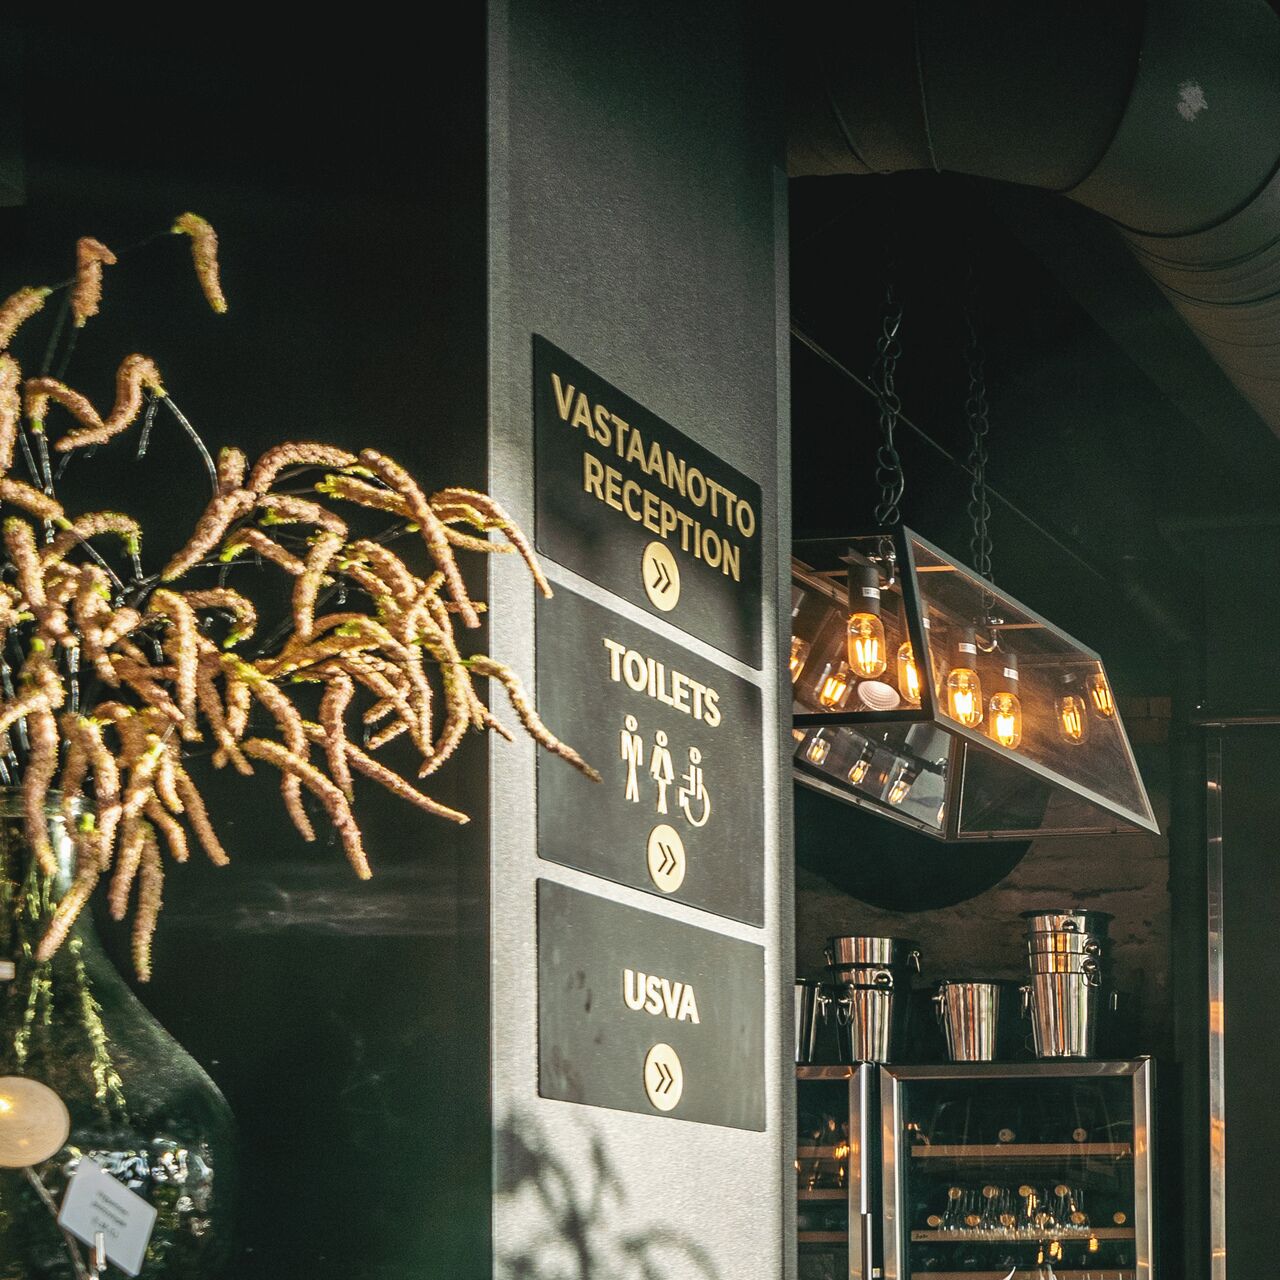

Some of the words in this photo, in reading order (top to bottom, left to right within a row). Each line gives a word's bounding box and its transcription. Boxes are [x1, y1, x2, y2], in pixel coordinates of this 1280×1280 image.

[550, 372, 756, 539] VASTAANOTTO
[583, 452, 741, 582] RECEPTION
[602, 638, 722, 727] TOILETS
[623, 969, 700, 1024] USVA
